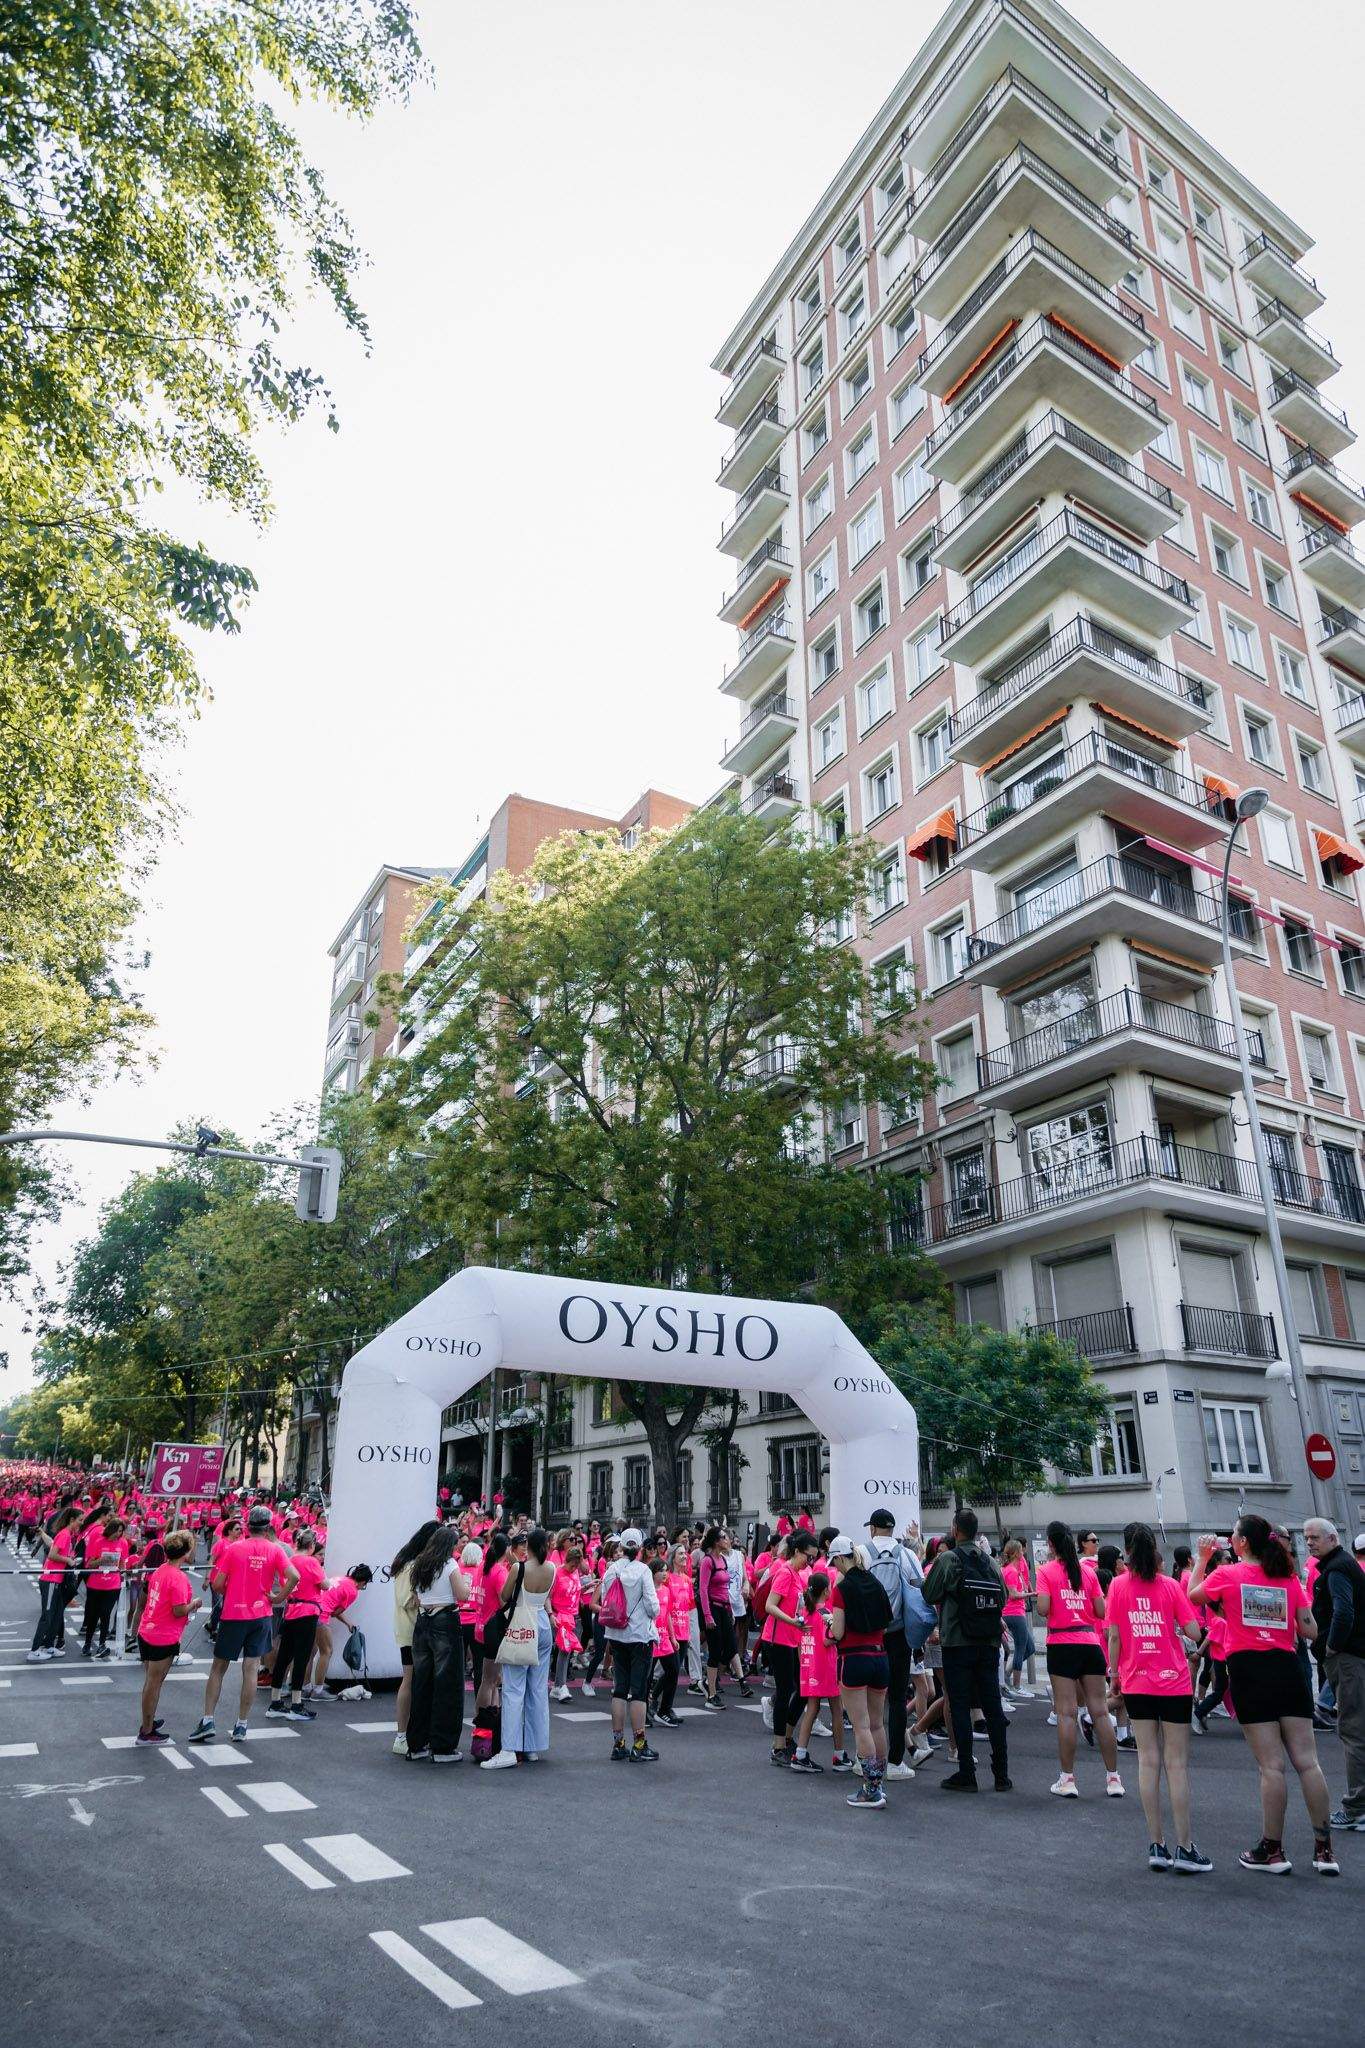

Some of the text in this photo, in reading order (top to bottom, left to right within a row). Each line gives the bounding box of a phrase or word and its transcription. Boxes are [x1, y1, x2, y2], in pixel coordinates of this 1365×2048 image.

[559, 1295, 779, 1361] OYSHO
[406, 1336, 481, 1358] OYSHO
[834, 1377, 892, 1394] OYSHO
[162, 1447, 190, 1463] Km
[358, 1445, 432, 1464] OYSHO
[162, 1466, 181, 1492] 6
[1136, 1597, 1151, 1610] TU
[1132, 1625, 1162, 1637] SUMA
